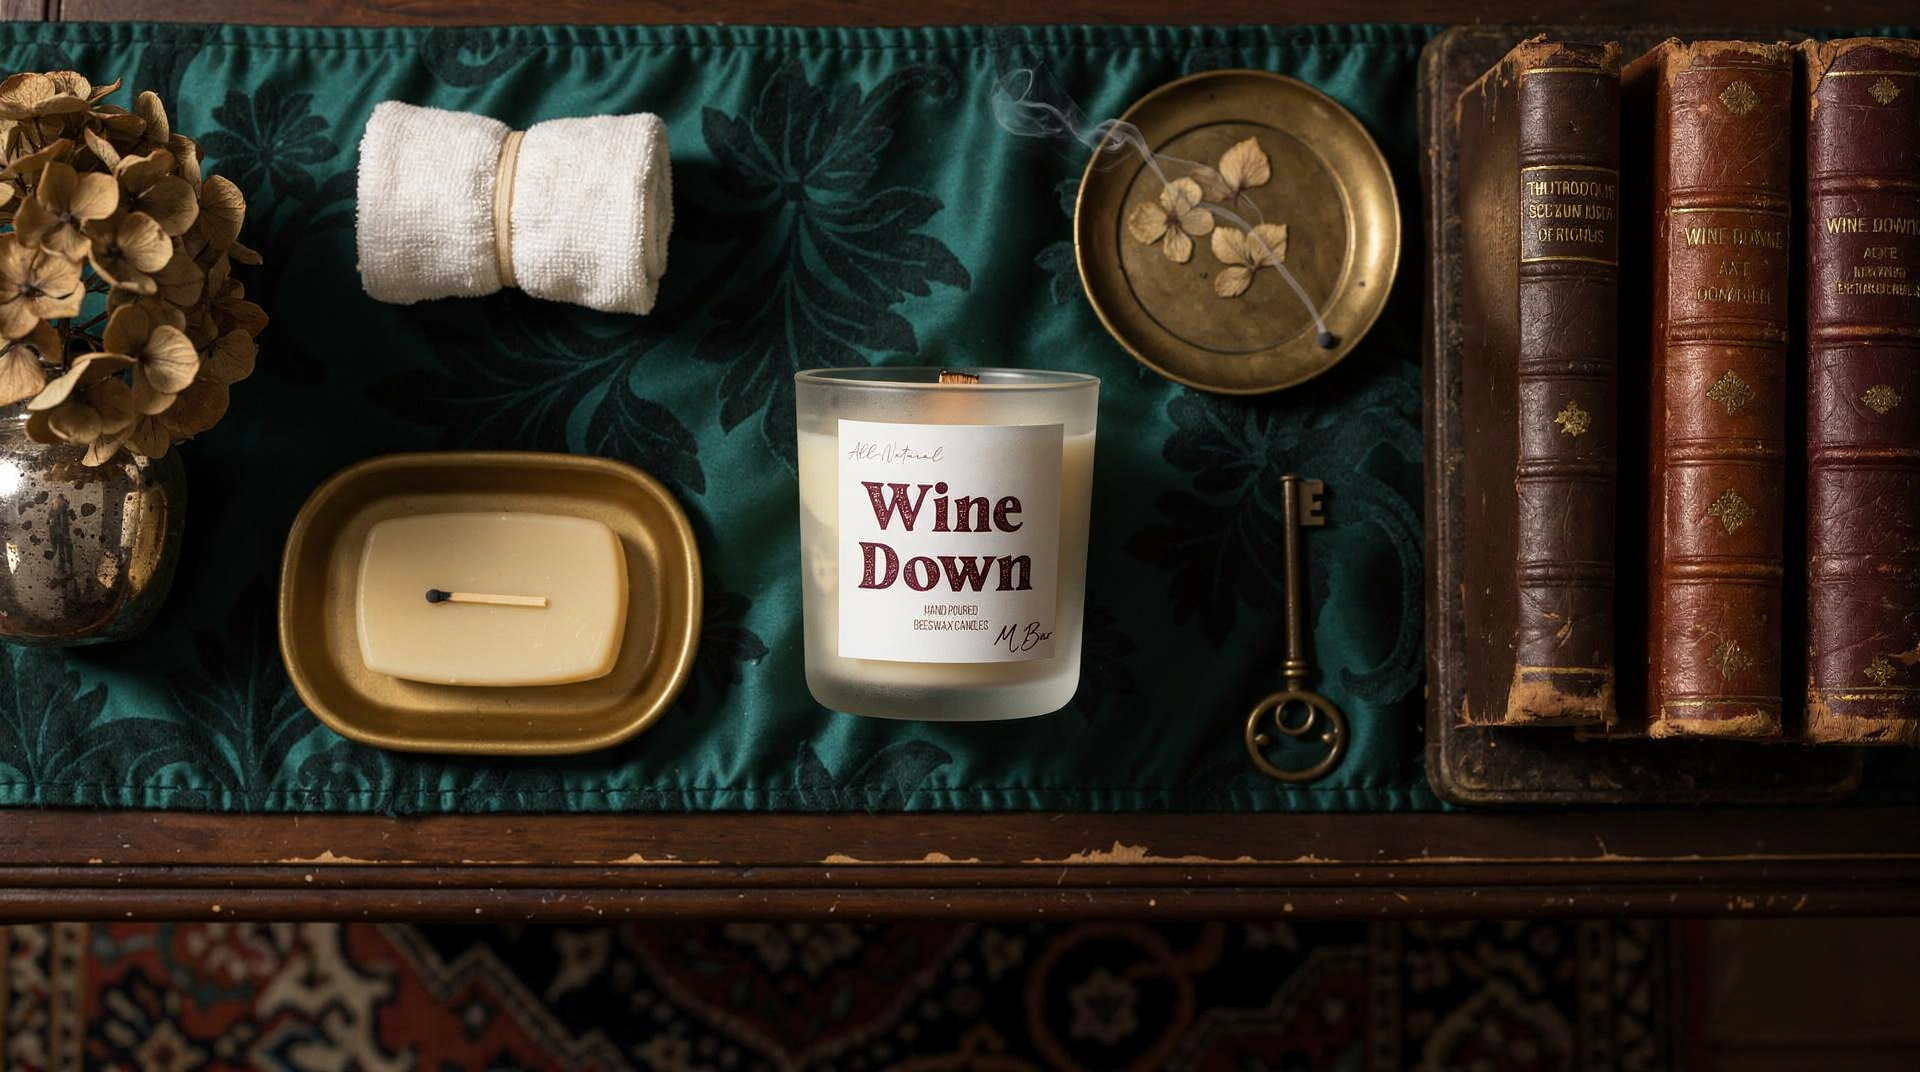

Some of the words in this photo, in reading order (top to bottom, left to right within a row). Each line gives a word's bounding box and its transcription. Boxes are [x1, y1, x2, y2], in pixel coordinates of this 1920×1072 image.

[1826, 217, 1868, 234] WINE
[1685, 227, 1727, 246] WINE
[849, 441, 880, 461] All
[861, 481, 1024, 533] Wine
[858, 541, 1033, 592] Down
[924, 604, 946, 616] HAND
[949, 604, 979, 616] POURED
[913, 619, 954, 631] BEESWAX
[954, 619, 989, 631] CANDLES
[994, 623, 1019, 653] M
